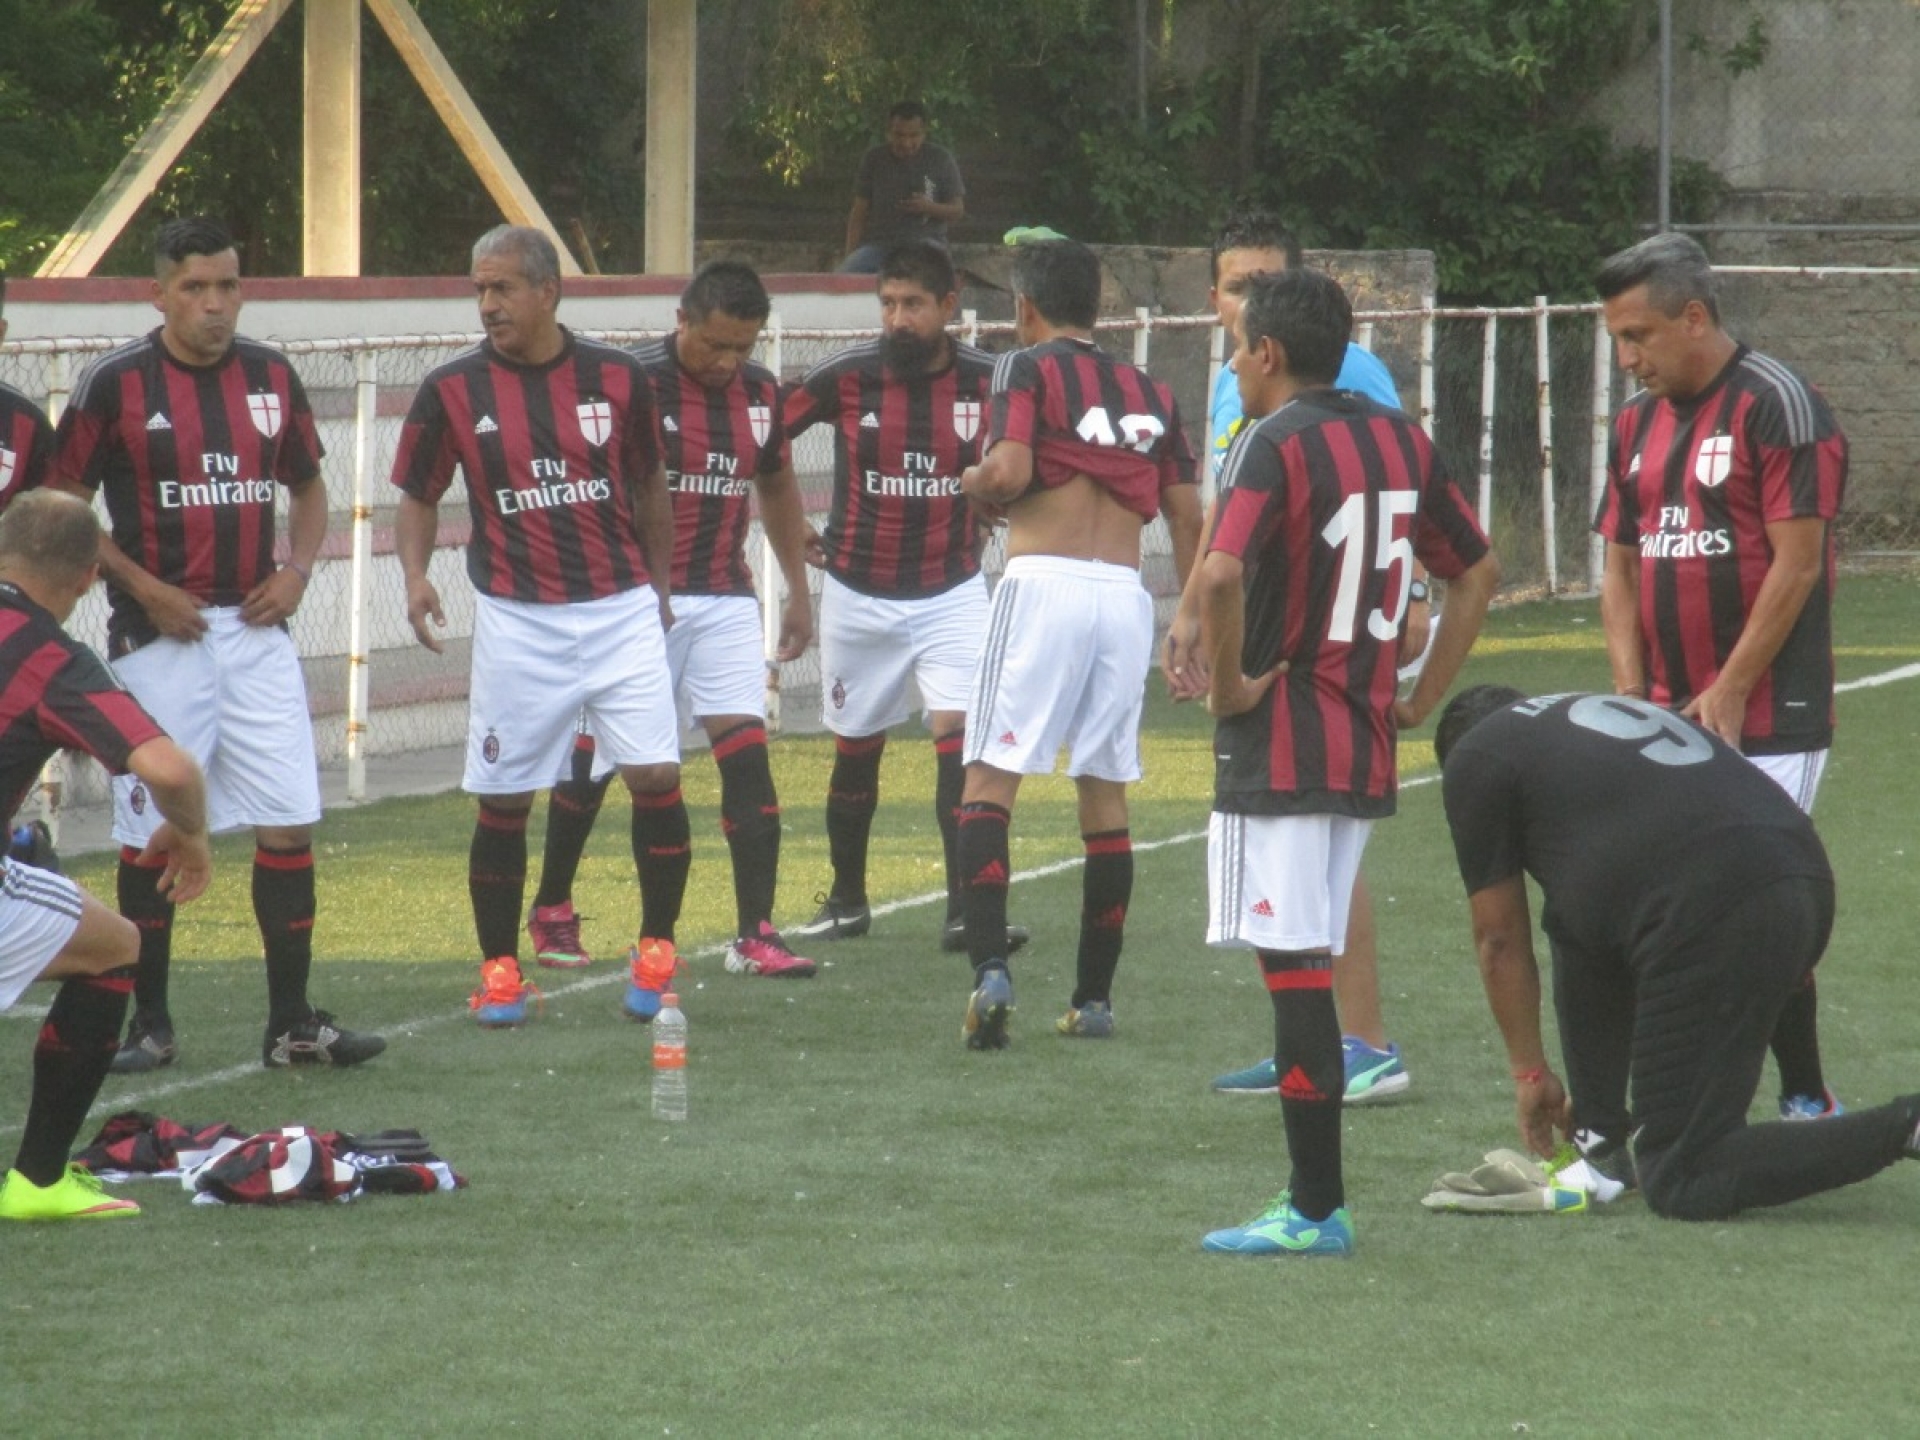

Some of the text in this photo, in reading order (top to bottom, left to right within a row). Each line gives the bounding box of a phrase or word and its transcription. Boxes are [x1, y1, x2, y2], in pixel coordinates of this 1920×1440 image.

[202, 453, 239, 475] Fly
[530, 458, 566, 478] Fly
[706, 452, 738, 475] Fly
[903, 452, 937, 473] Fly
[159, 477, 273, 508] Emirates
[865, 469, 964, 497] Emirate
[496, 478, 610, 514] Emirates
[1659, 506, 1689, 529] Fly
[1321, 490, 1418, 641] 15
[1568, 694, 1715, 766] 9
